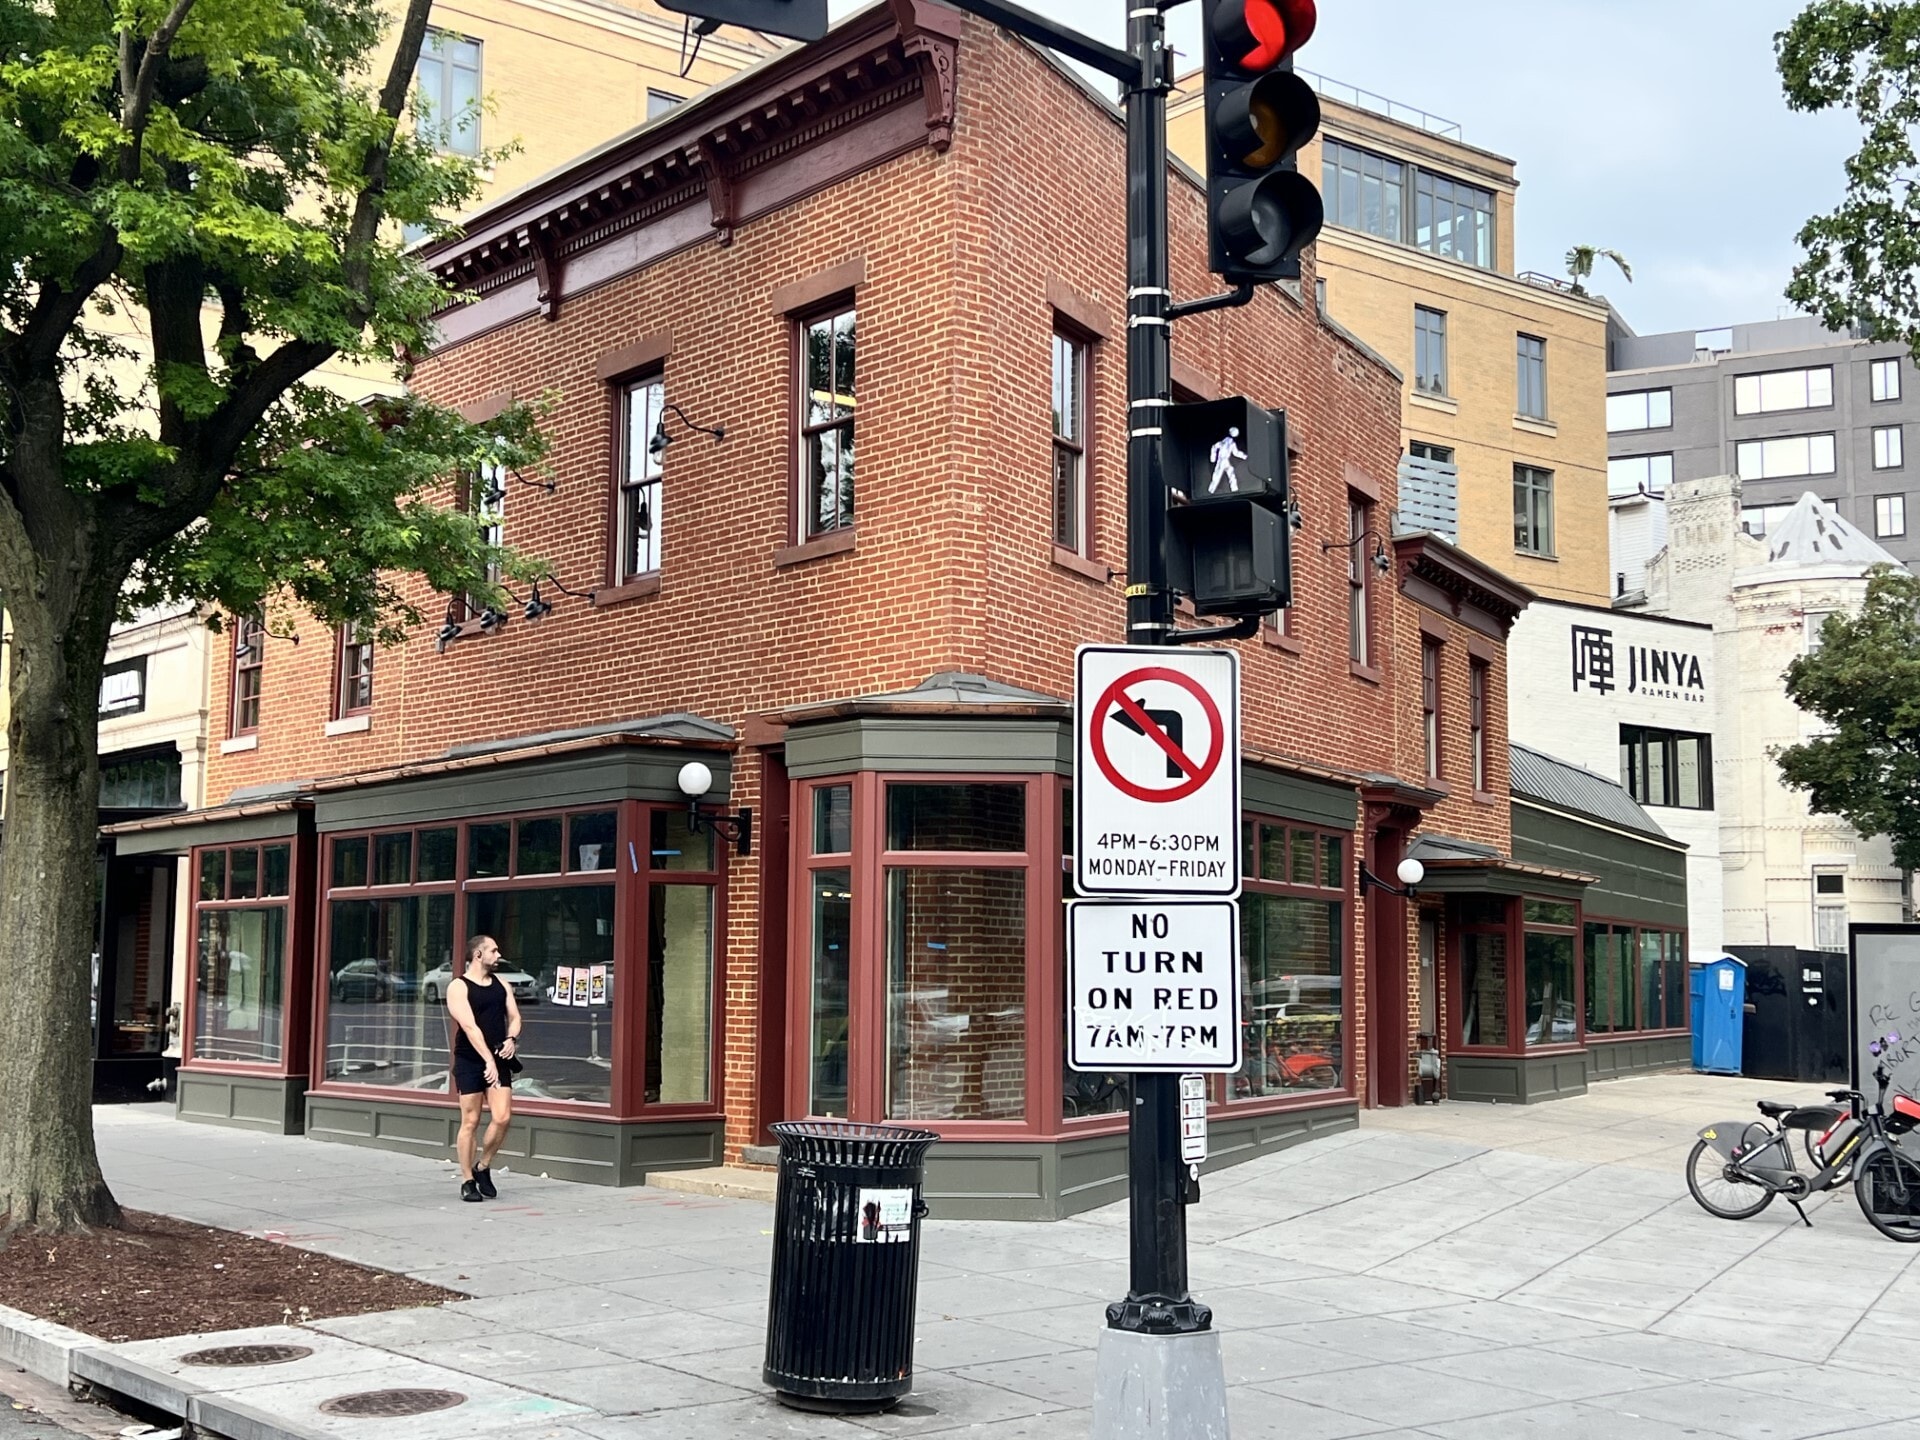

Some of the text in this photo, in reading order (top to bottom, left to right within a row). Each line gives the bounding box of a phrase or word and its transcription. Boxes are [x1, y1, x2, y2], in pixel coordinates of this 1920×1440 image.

[1628, 646, 1704, 693] JINYA
[1641, 687, 1705, 703] RAMEN BAR
[1097, 833, 1219, 851] 4PM-6:30PM
[1089, 858, 1226, 877] MONDAY-FRIDAY
[1132, 913, 1168, 939] NO
[1102, 951, 1203, 973] TURN
[1088, 988, 1218, 1010] ON RED
[1087, 1025, 1217, 1048] 7AM-7PM
